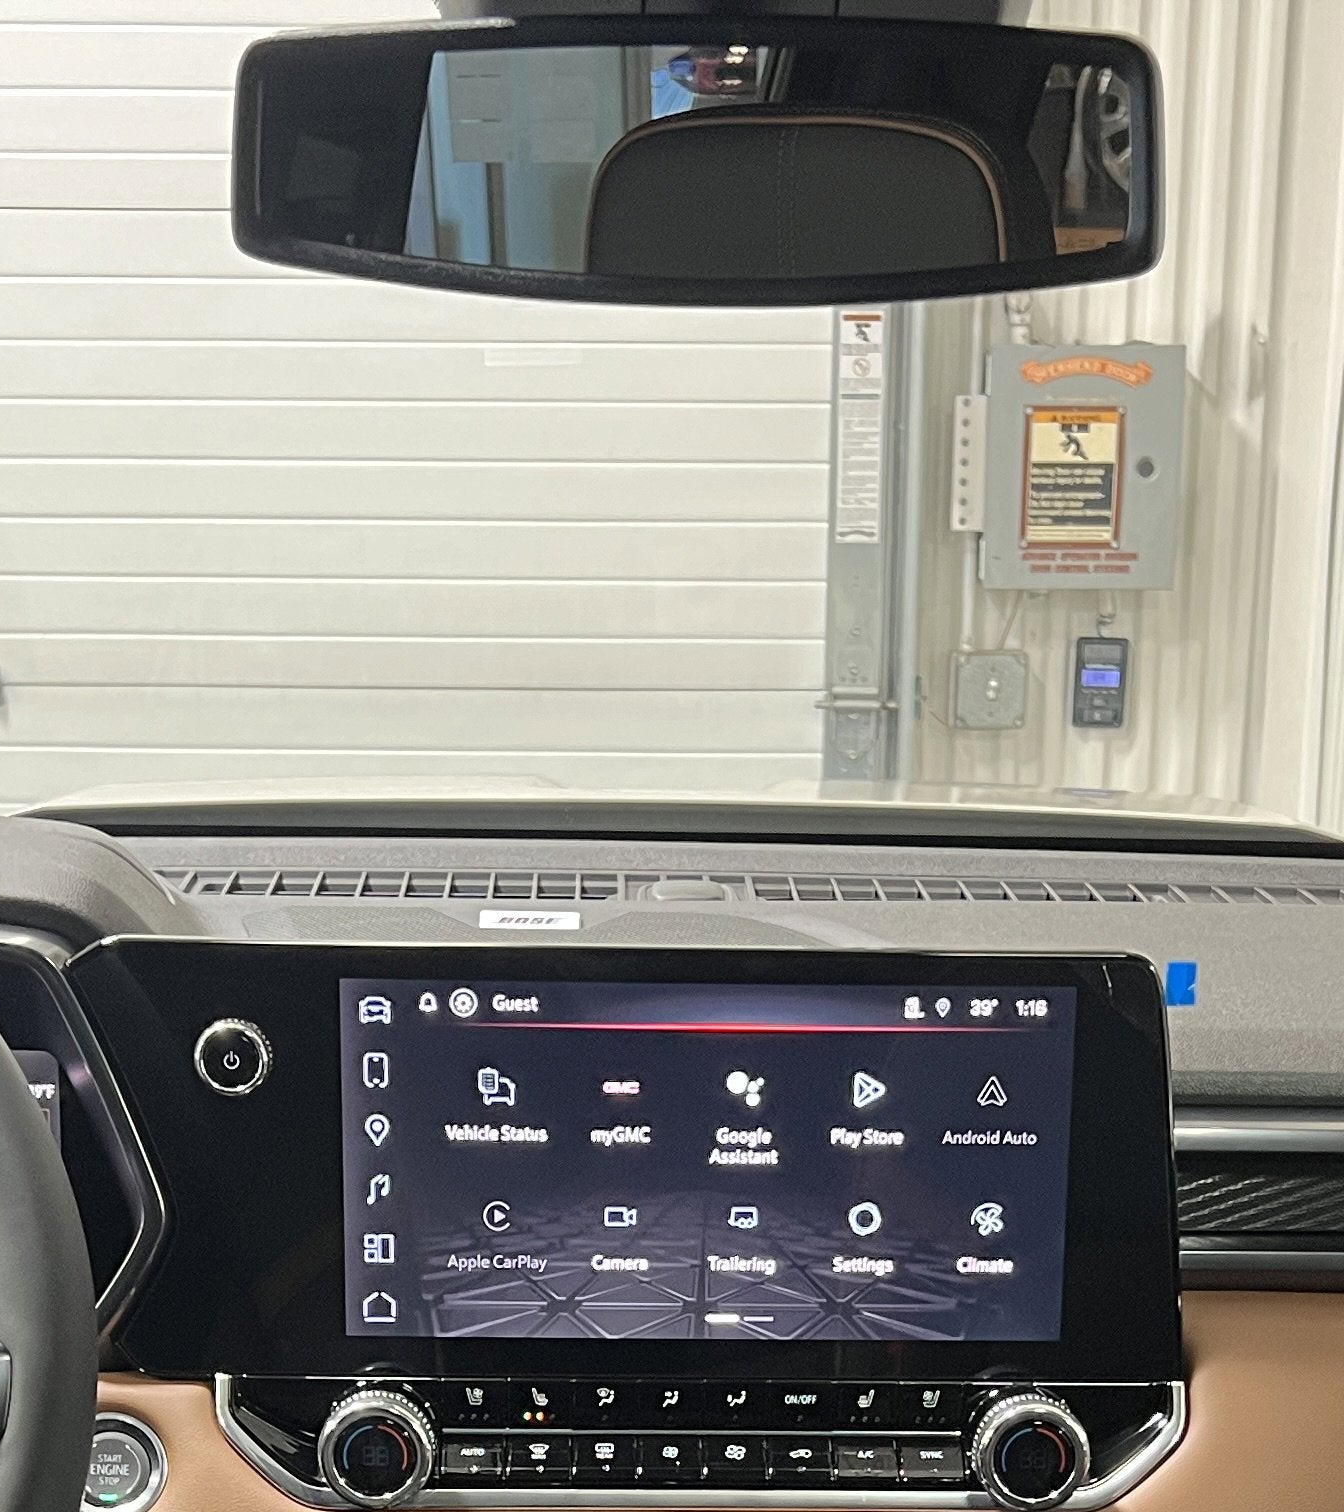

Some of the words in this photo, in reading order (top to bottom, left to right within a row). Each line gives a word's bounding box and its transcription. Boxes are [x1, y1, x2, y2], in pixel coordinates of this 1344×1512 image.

[492, 994, 539, 1014] Guest
[444, 1124, 500, 1143] Vehicle
[501, 1124, 549, 1143] Status
[590, 1126, 651, 1147] myGMC
[715, 1126, 773, 1148] Google
[829, 1127, 862, 1149] Play
[862, 1128, 905, 1146] Store
[941, 1130, 1000, 1146] Android
[1002, 1131, 1038, 1146] Auto
[708, 1149, 779, 1166] Assistant
[447, 1255, 490, 1273] Apple
[492, 1255, 548, 1273] CarPlay
[590, 1255, 650, 1272] Camera
[706, 1256, 777, 1276] Trailering
[831, 1256, 895, 1277] Settings
[955, 1256, 1015, 1274] Climate
[784, 1395, 817, 1405] ON/OFF
[97, 1453, 123, 1463] START
[460, 1448, 486, 1457] AUTO
[89, 1463, 130, 1477] ENGINE
[98, 1476, 121, 1486] STOP
